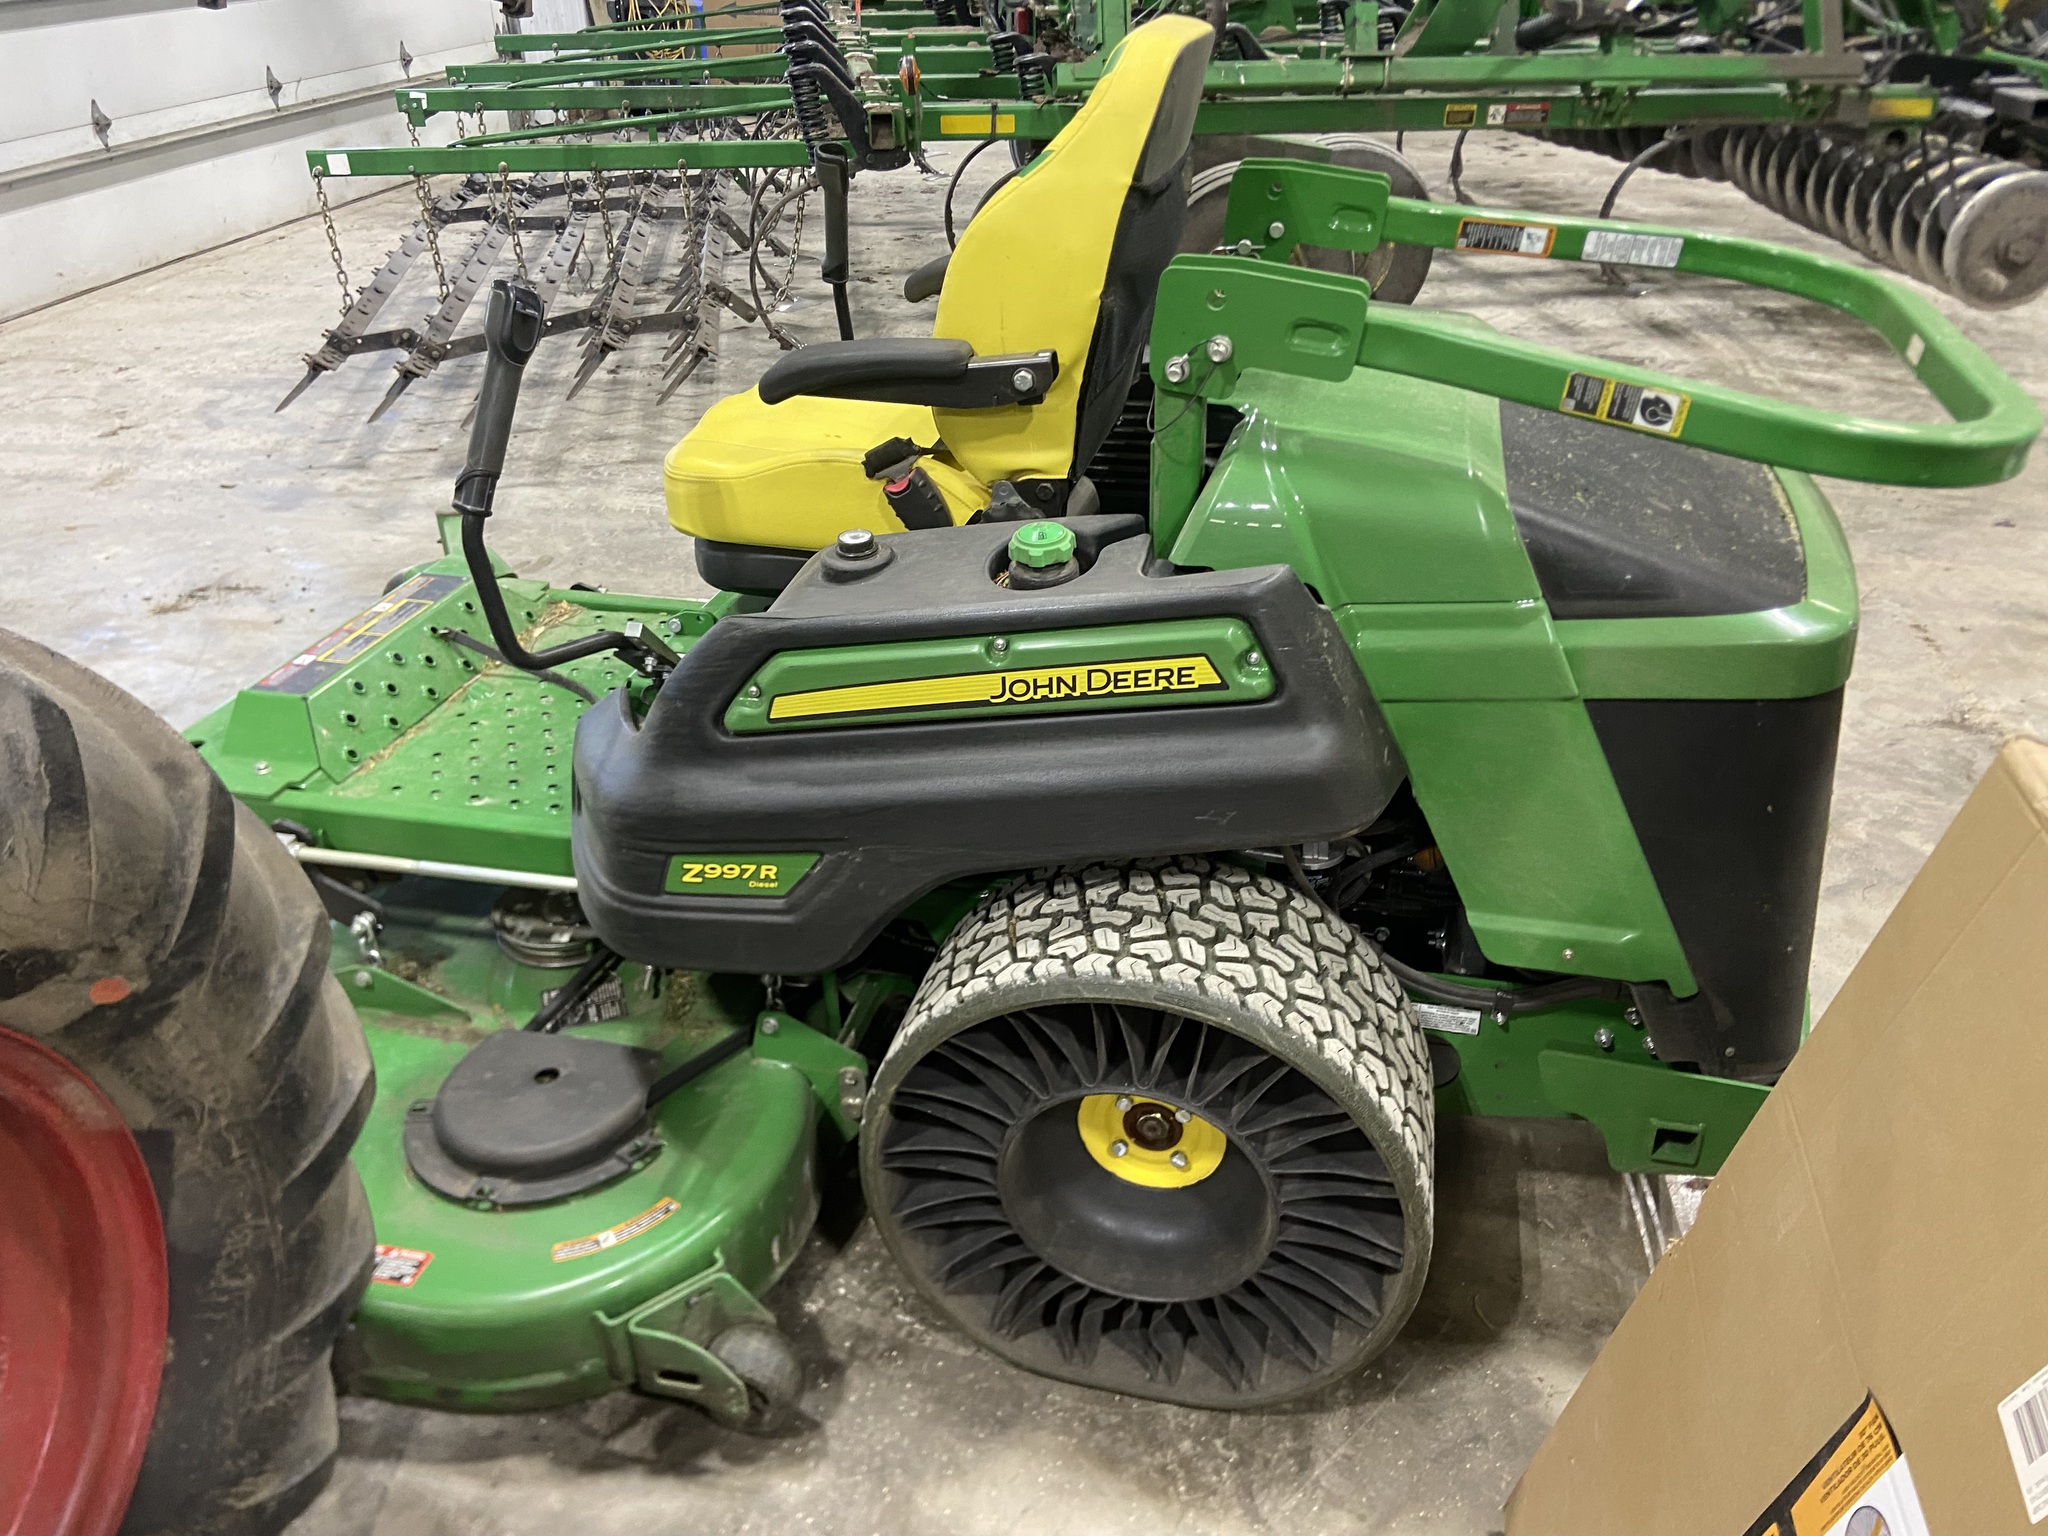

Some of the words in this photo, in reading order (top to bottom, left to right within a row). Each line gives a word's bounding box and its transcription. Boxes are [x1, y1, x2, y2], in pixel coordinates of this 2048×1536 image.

[989, 674, 1077, 700] JOHN
[1087, 666, 1196, 693] DEERE
[681, 863, 778, 883] Z997R
[749, 880, 778, 888] Diesel
